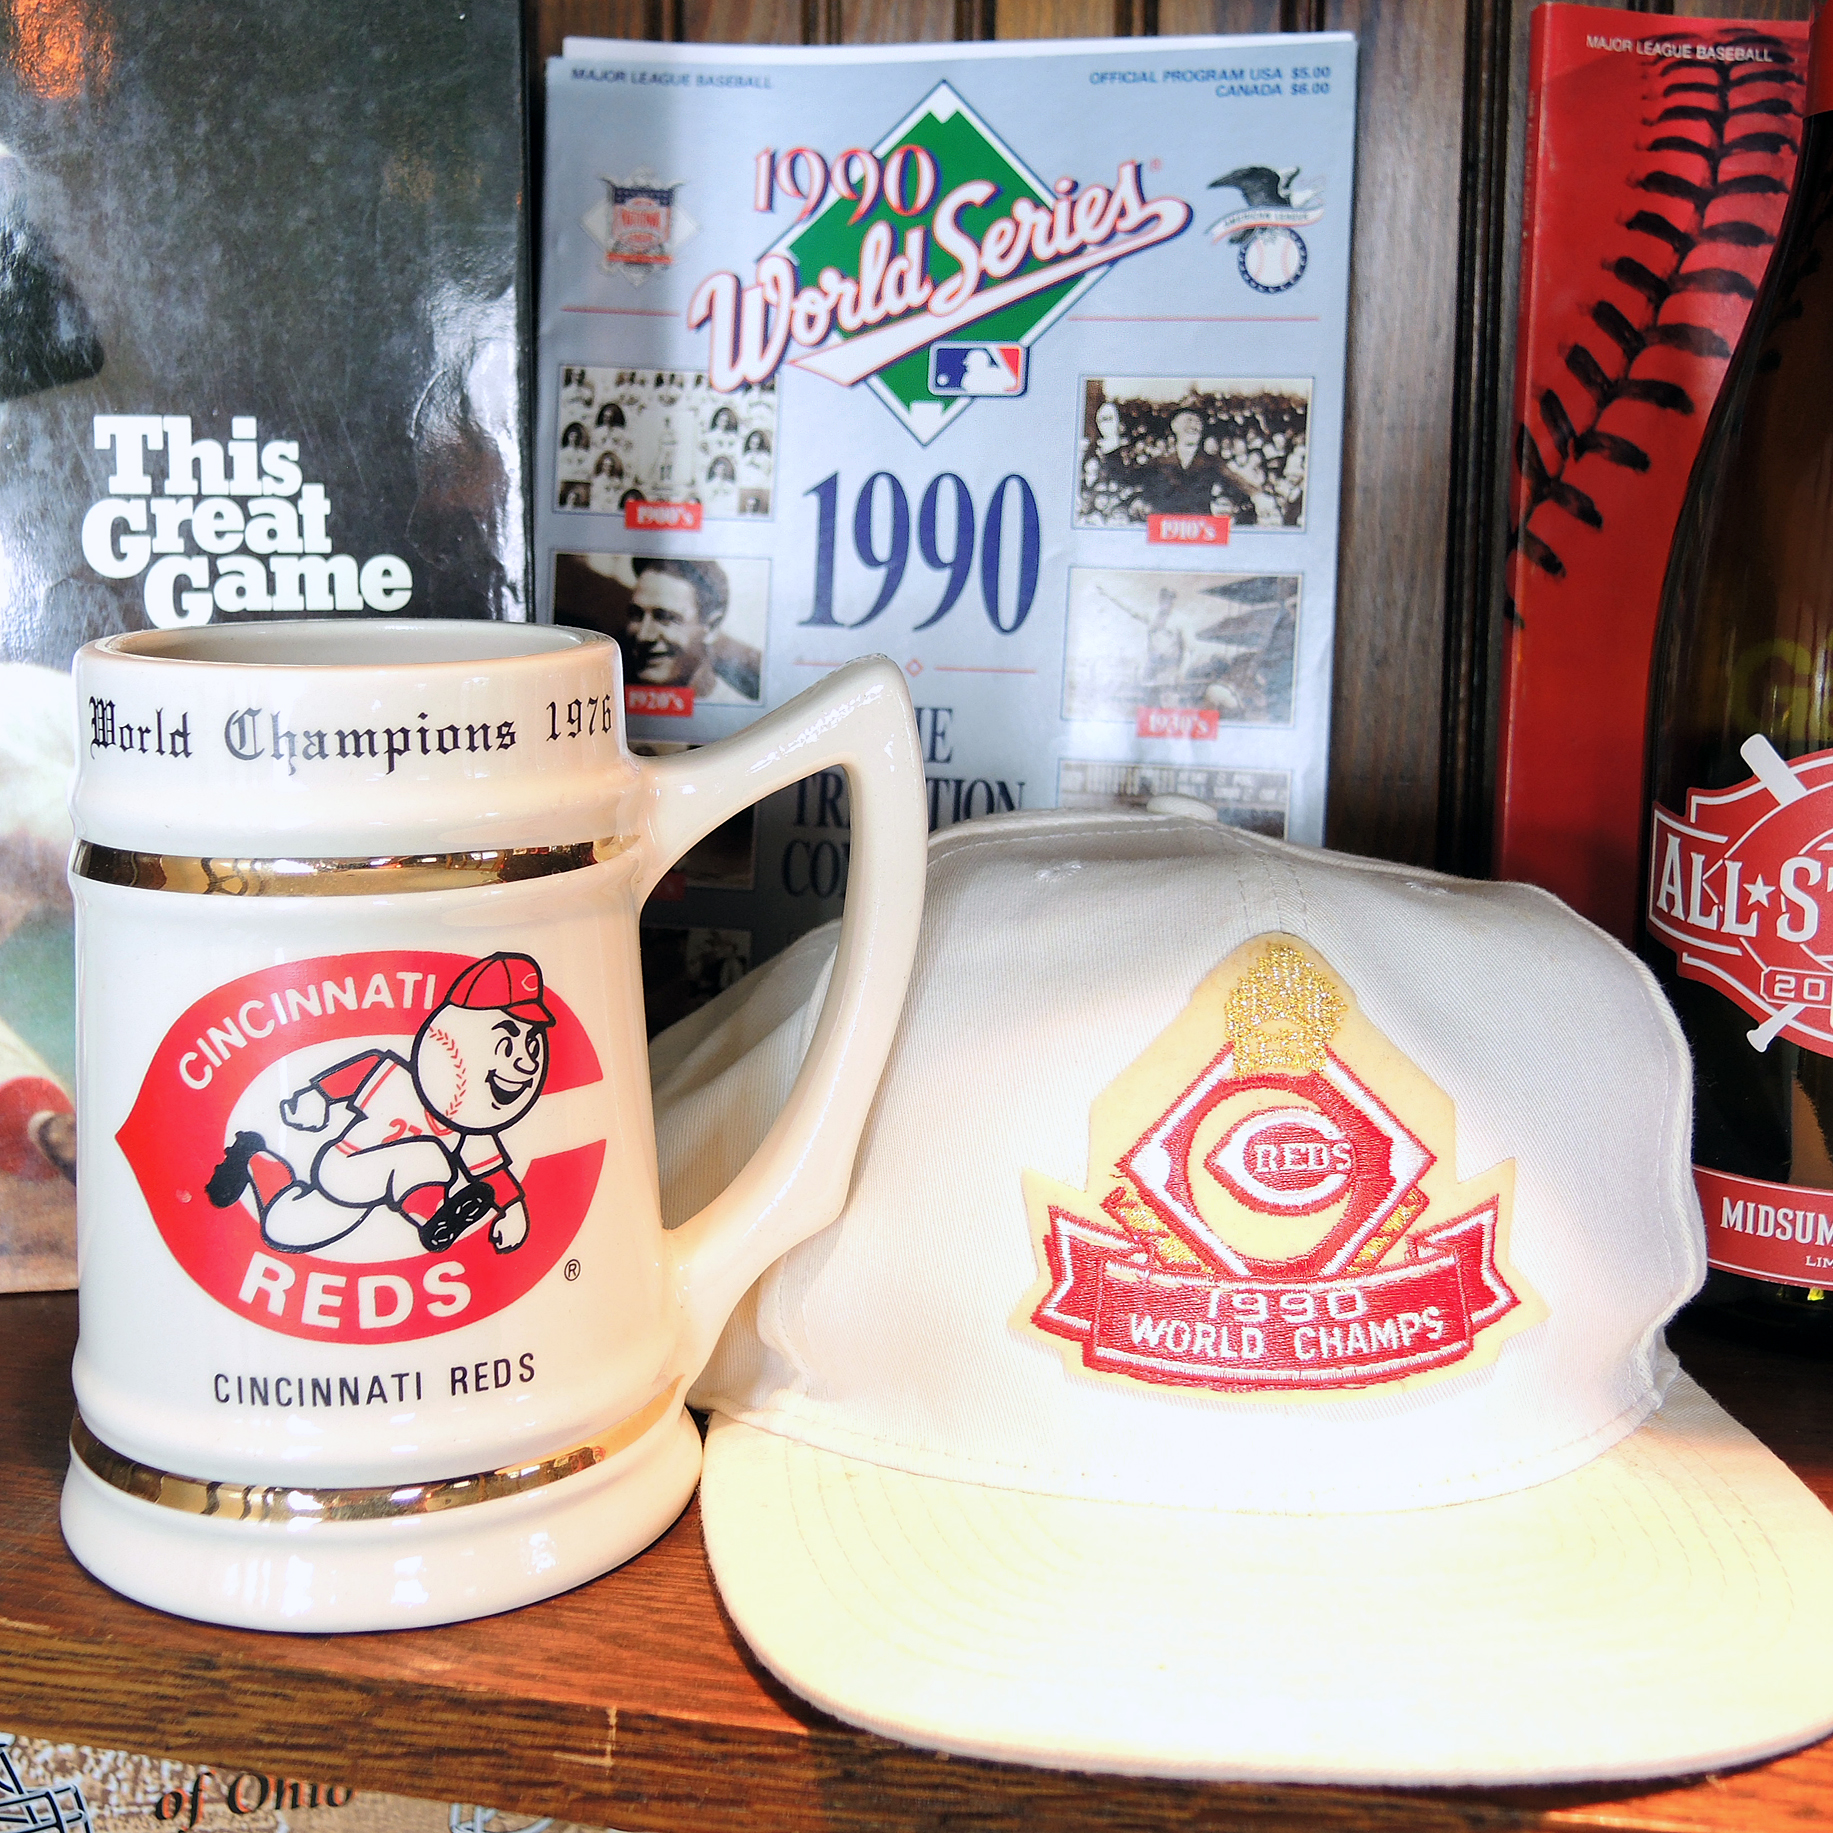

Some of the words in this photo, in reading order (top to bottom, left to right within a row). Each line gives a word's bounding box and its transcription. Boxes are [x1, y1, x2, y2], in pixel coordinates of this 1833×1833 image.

[571, 68, 626, 83] MAJOR
[631, 71, 690, 87] LEAGUE
[696, 73, 772, 89] BASEBALL
[1089, 70, 1158, 85] OFFICIAL
[1162, 68, 1245, 83] PROGRAM
[1250, 67, 1283, 81] USA
[1291, 65, 1332, 80] $5.00
[1586, 35, 1633, 52] MAJOR
[1636, 41, 1693, 58] LEAGUE
[1696, 44, 1773, 62] BASEBALL
[1215, 82, 1283, 98] CANADA
[753, 144, 942, 226] 1990
[687, 220, 936, 394] World
[927, 158, 1148, 318] Series
[93, 414, 304, 498] This
[81, 482, 333, 580] Great
[797, 469, 1041, 636] 1990
[1160, 519, 1217, 541] 1910's
[143, 553, 414, 630] Game
[88, 695, 194, 760] World
[223, 706, 517, 776] Champions
[545, 694, 614, 743] 1976
[1656, 832, 1759, 938] ALL
[1776, 856, 1833, 943] S
[1773, 973, 1827, 1002] 20
[178, 970, 437, 1091] CINCINNATI
[1252, 1140, 1353, 1174] REDS
[238, 1250, 473, 1331] REDS
[1208, 1284, 1367, 1324] 1990
[1129, 1312, 1266, 1361] WORLD
[1293, 1304, 1446, 1363] CHAMPS
[213, 1371, 423, 1409] CINCINNATI
[449, 1351, 537, 1397] REDS
[155, 1768, 219, 1833] of
